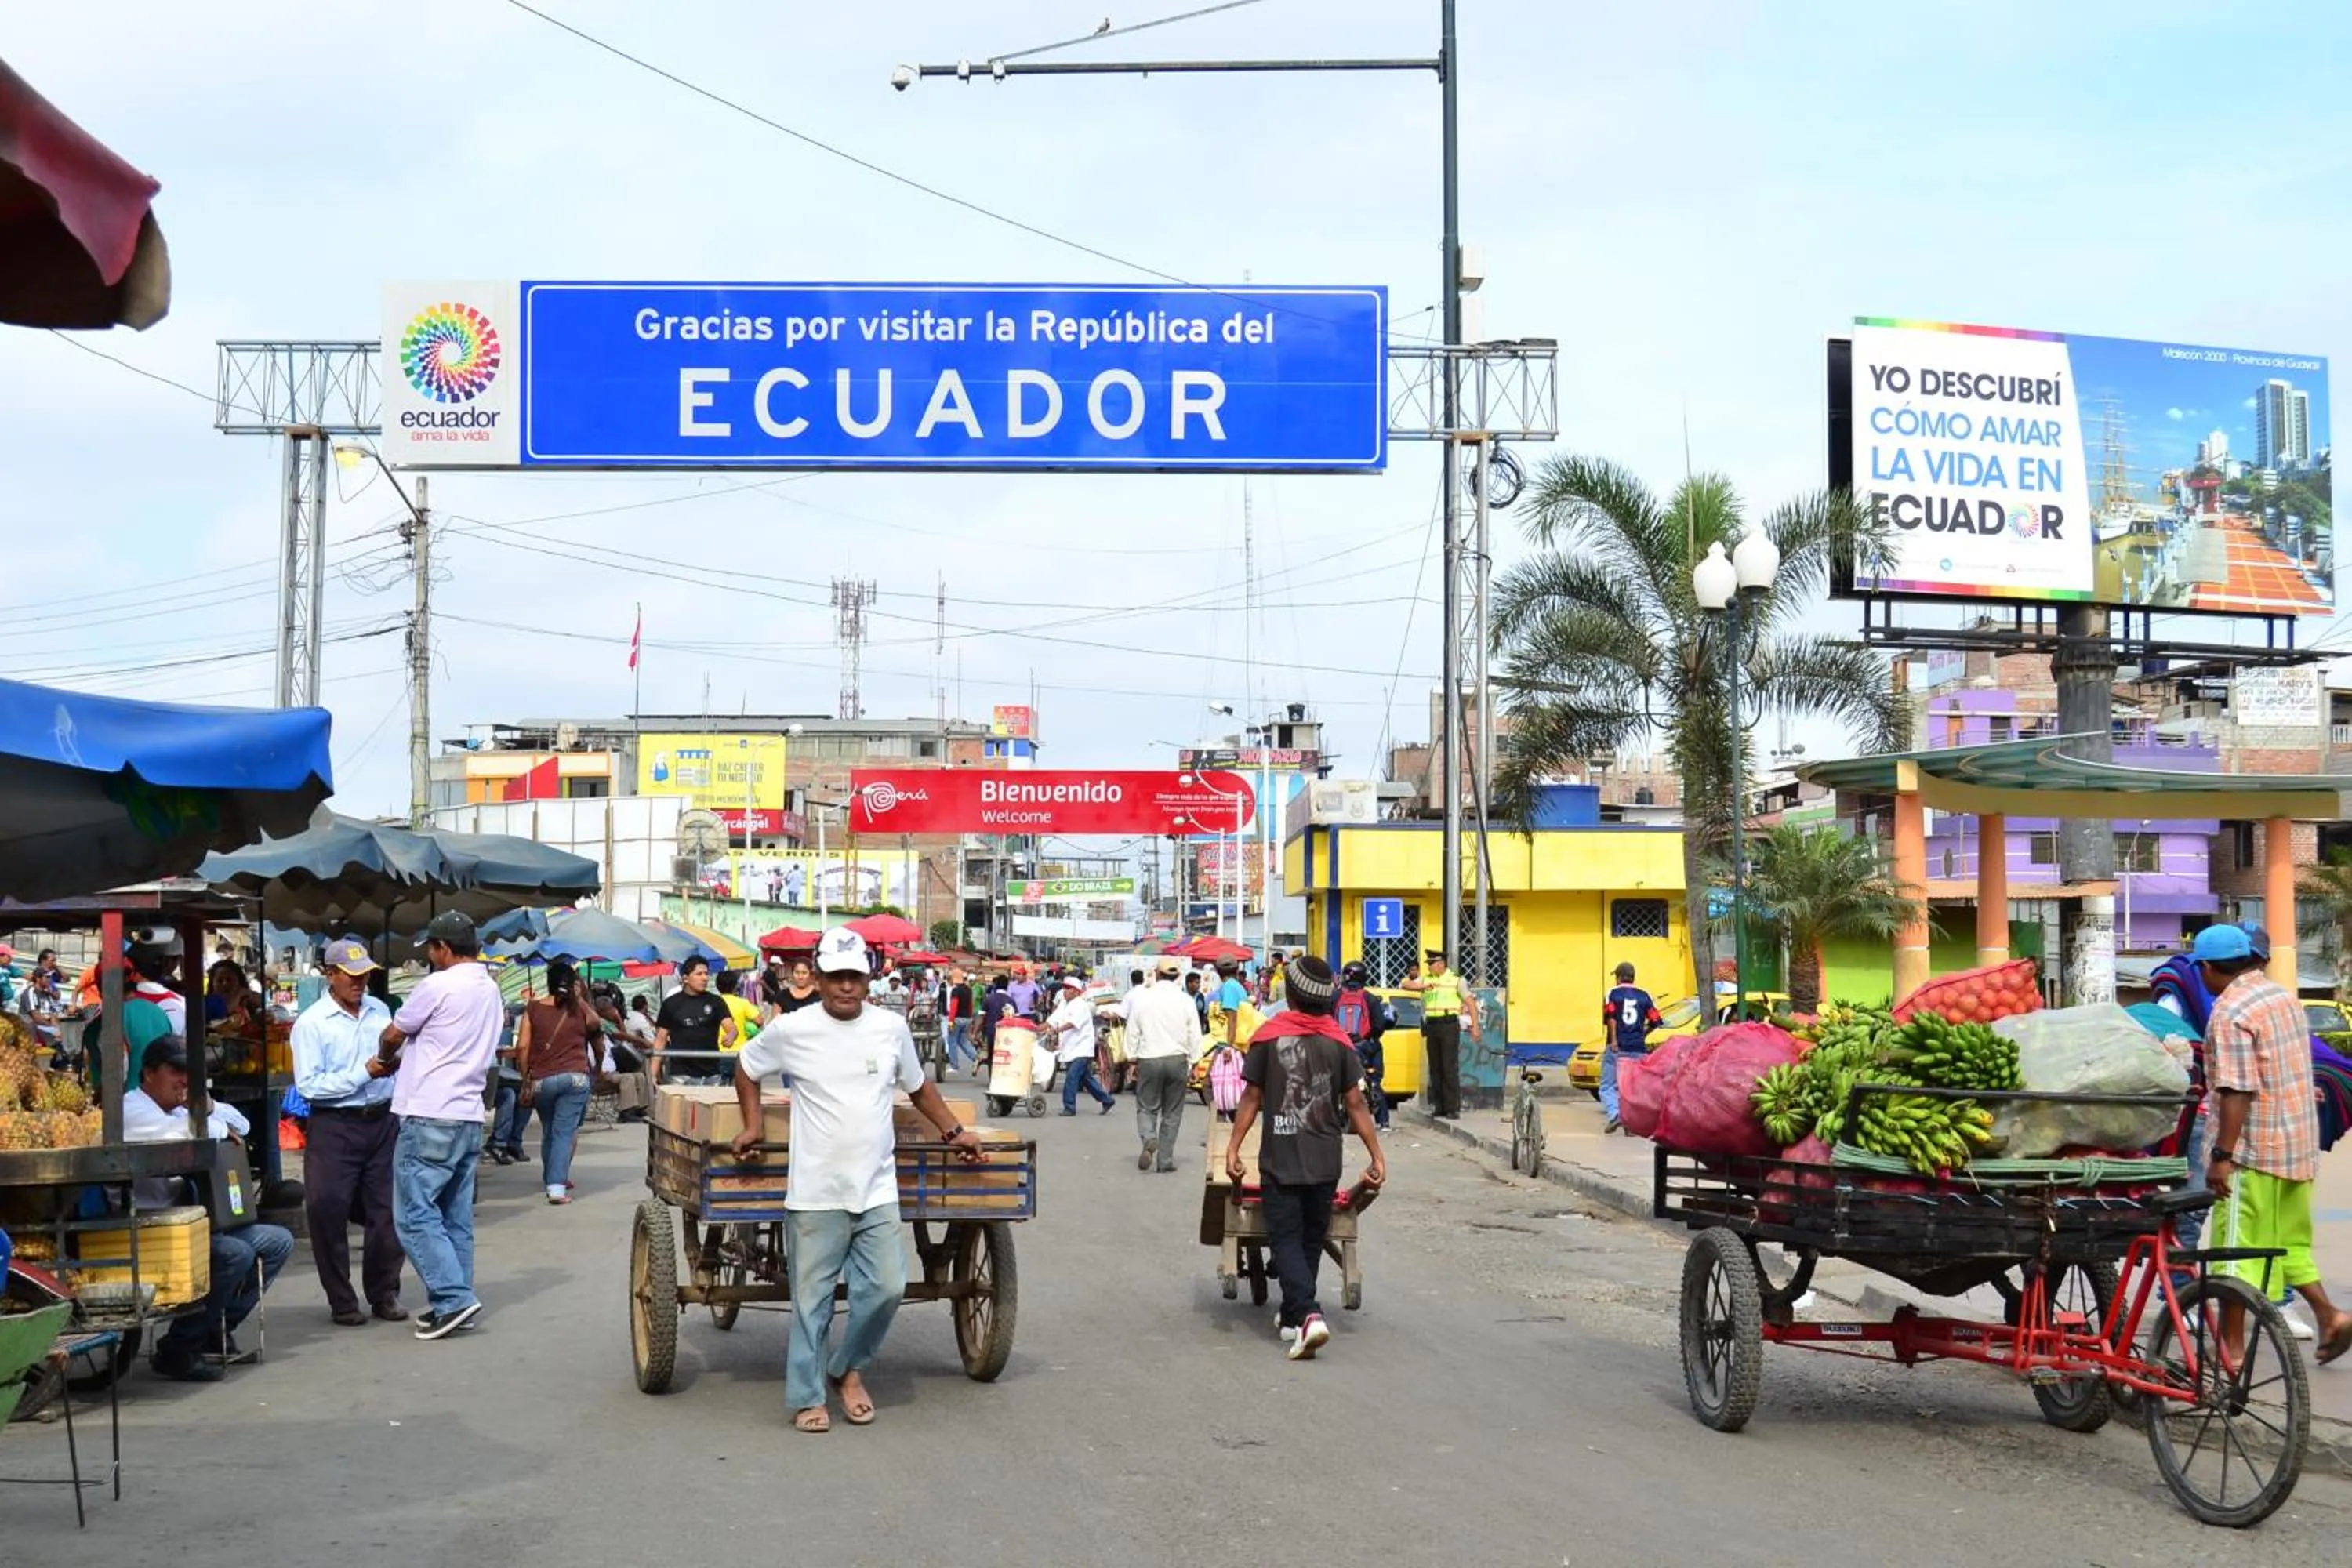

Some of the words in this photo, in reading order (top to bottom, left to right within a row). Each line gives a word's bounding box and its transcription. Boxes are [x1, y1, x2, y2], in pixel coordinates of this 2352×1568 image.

[635, 307, 773, 341] Gracias
[786, 315, 846, 349] por
[858, 309, 973, 342] visitar
[985, 310, 1015, 343] la
[1030, 310, 1209, 350] República
[1221, 311, 1274, 344] del
[1869, 364, 1911, 394] YO
[1920, 368, 2061, 406] DESCUBRÍ
[401, 405, 501, 428] ecuador
[678, 367, 1227, 441] ECUADOR
[411, 430, 443, 441] ama
[446, 430, 459, 441] la
[462, 430, 490, 441] vida
[1870, 401, 1973, 441] CÓMO
[1980, 416, 2062, 448] AMAR
[1871, 445, 1915, 482] LA
[1923, 449, 2008, 489] VIDA
[2018, 457, 2063, 493] EN
[981, 780, 1122, 803] Bienvenido
[981, 810, 1052, 823] Welcome
[1622, 997, 1638, 1025] 5
